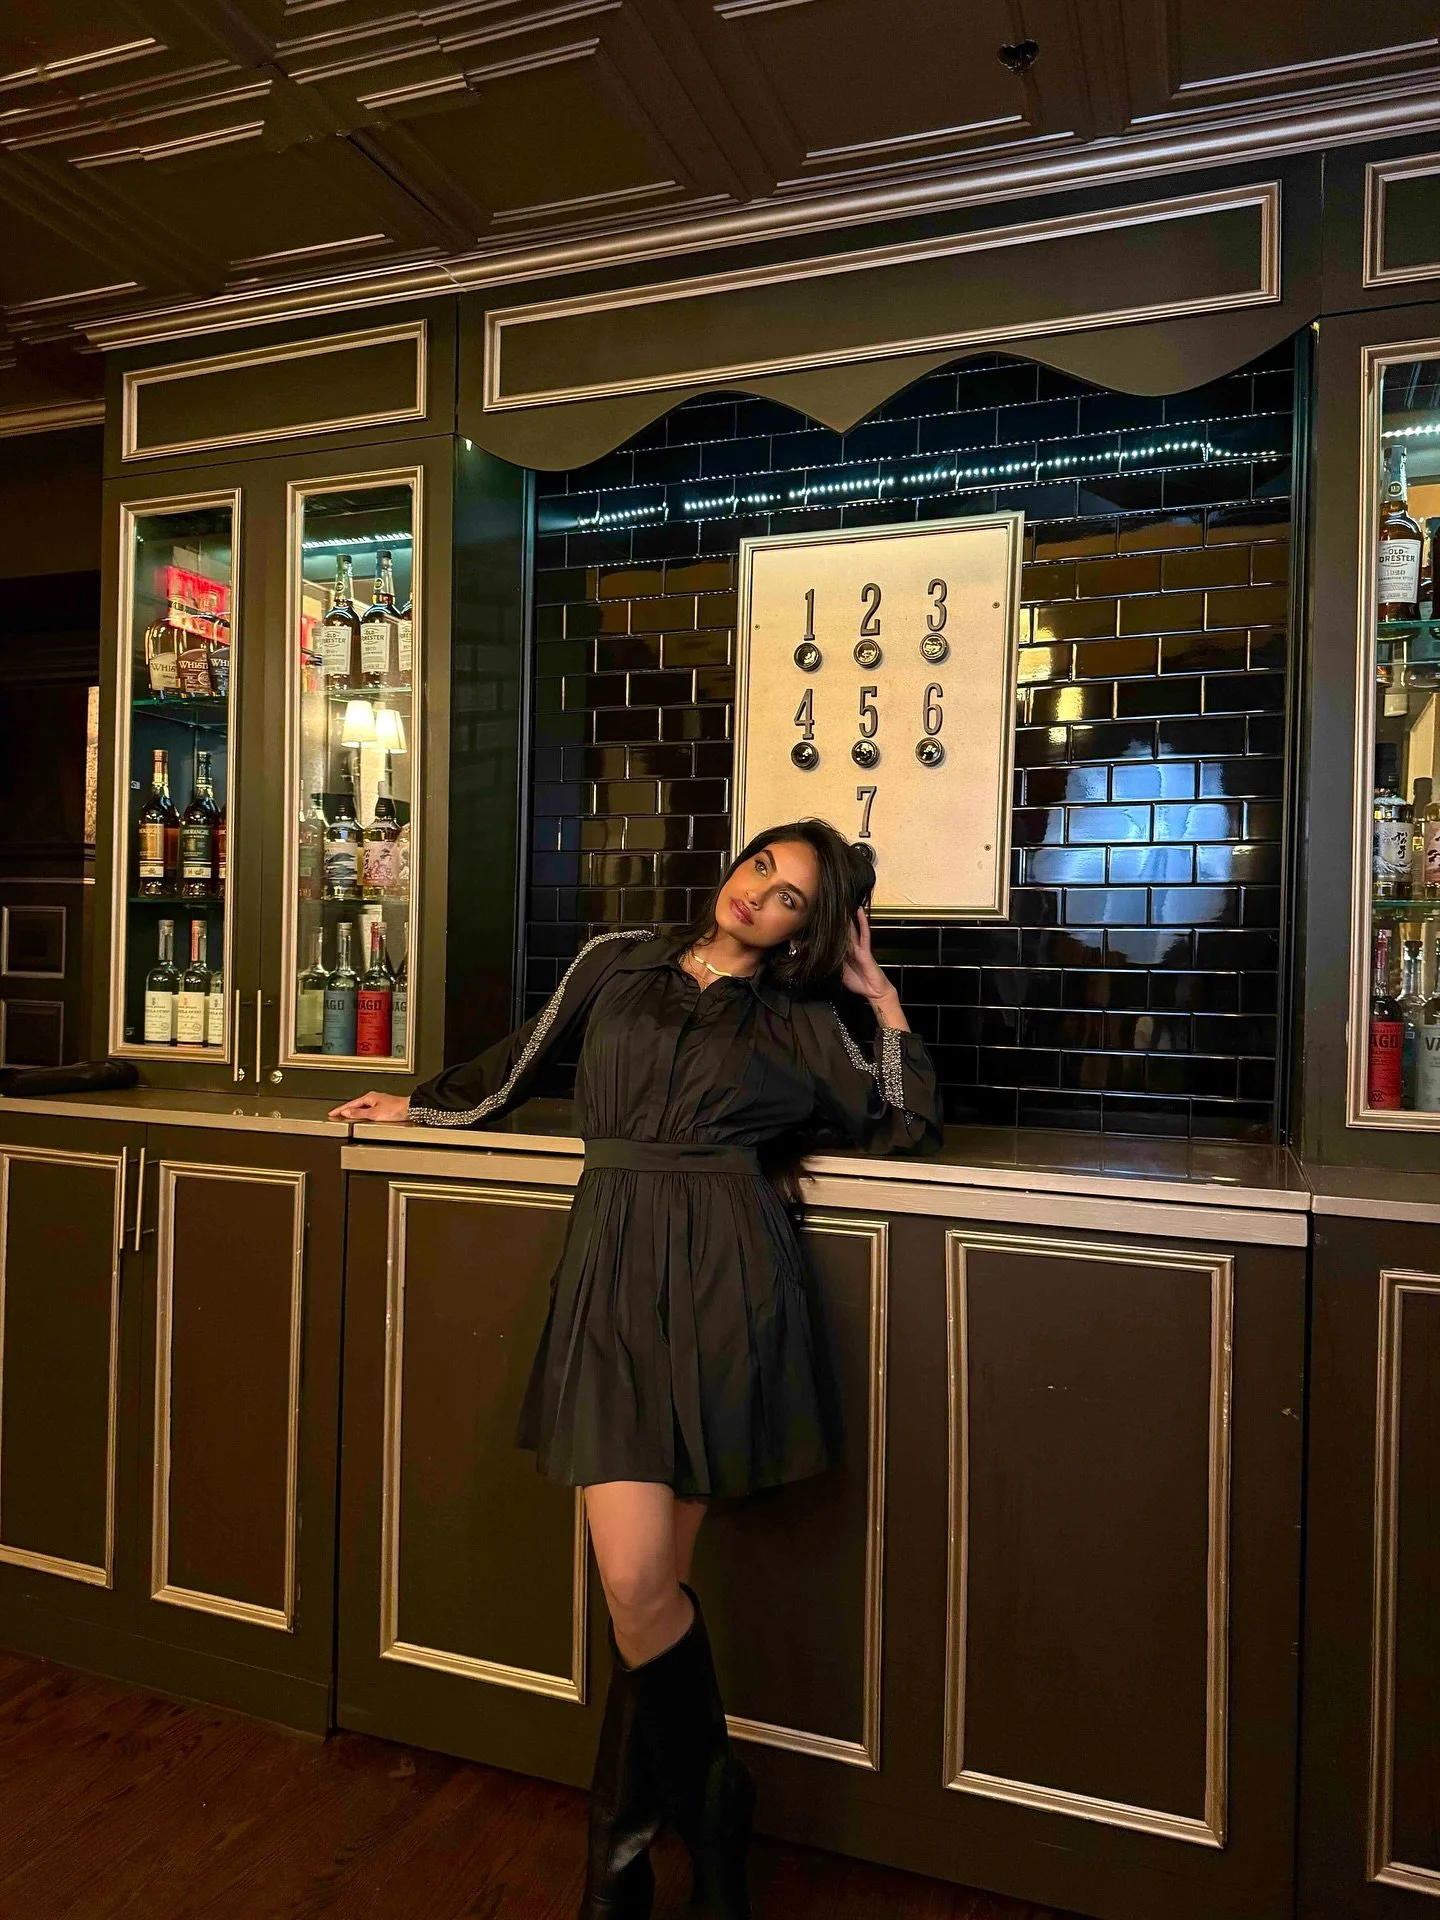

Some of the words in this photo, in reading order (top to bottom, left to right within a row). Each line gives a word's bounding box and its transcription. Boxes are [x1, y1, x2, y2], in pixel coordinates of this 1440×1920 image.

[804, 588, 816, 641] 1
[860, 582, 882, 637] 2
[926, 577, 948, 632] 3
[793, 688, 815, 740] 4
[858, 685, 878, 738] 5
[922, 682, 943, 735] 6
[856, 785, 878, 838] 7
